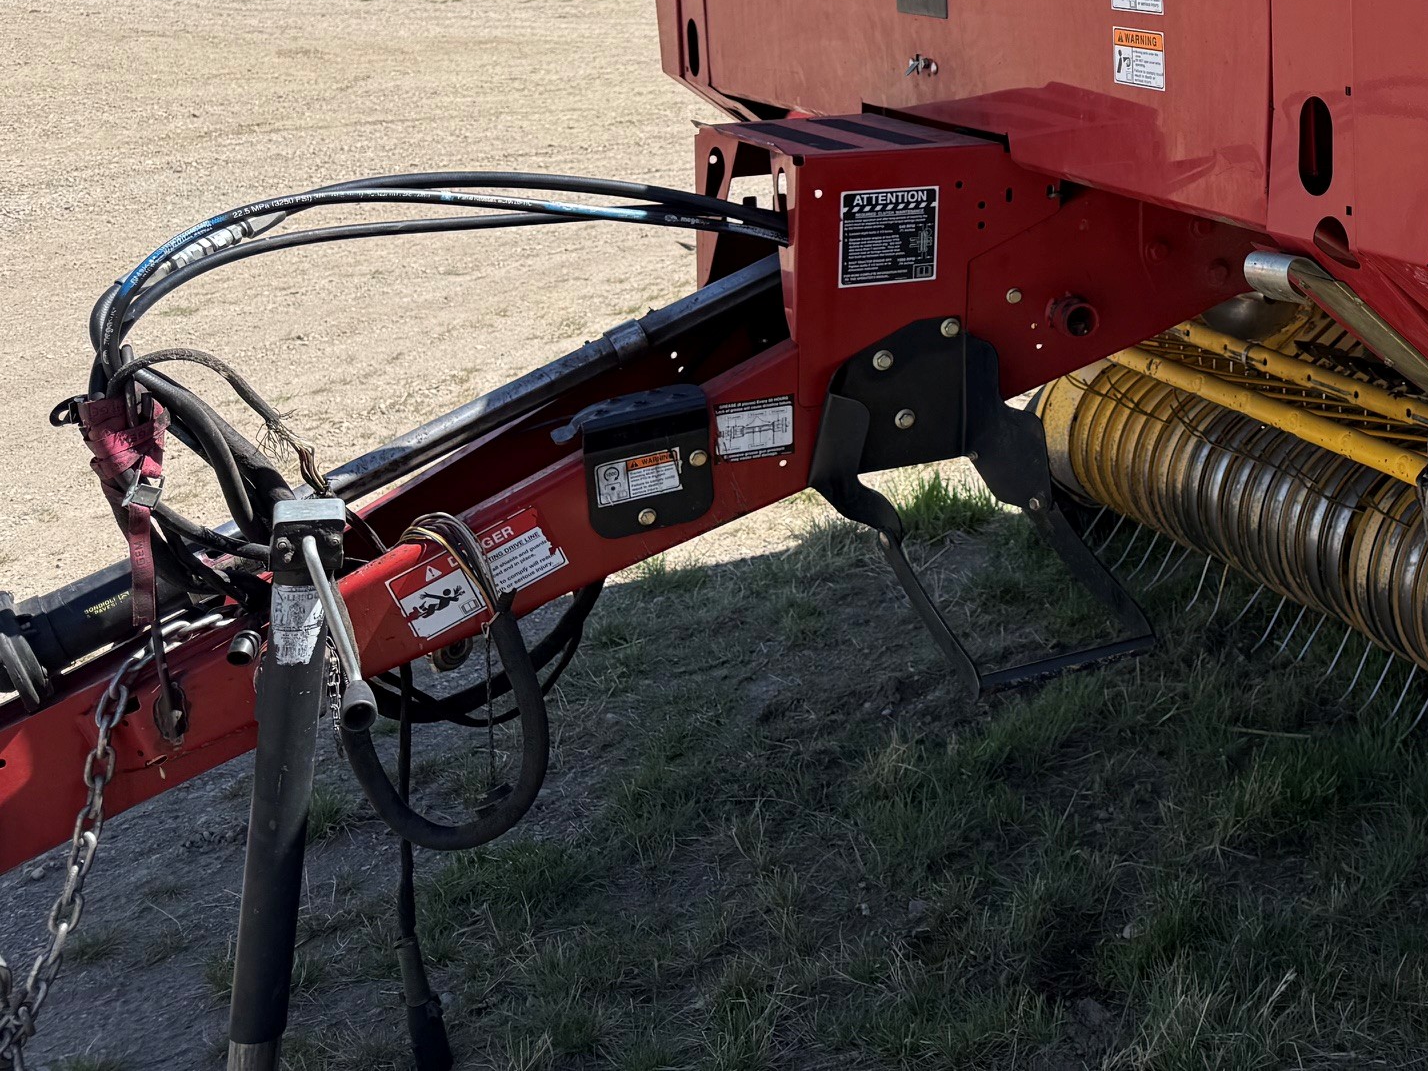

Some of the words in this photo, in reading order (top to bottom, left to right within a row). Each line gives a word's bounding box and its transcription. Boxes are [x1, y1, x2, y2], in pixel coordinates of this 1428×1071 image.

[1124, 33, 1157, 47] WARNING
[232, 208, 251, 219] 22.5
[250, 202, 271, 213] MPa
[271, 196, 294, 209] (3250
[295, 194, 313, 203] PSI)
[852, 191, 927, 206] ATTENTION
[641, 452, 671, 465] WARNIN
[503, 539, 523, 554] DRIVE
[524, 531, 541, 543] LINE
[499, 556, 518, 568] shields
[518, 549, 529, 557] and
[529, 540, 547, 553] guards
[503, 564, 514, 573] and
[520, 553, 537, 564] place.
[507, 566, 528, 581] comply
[528, 561, 539, 569] will
[514, 571, 536, 585] serious
[535, 561, 554, 573] injury.
